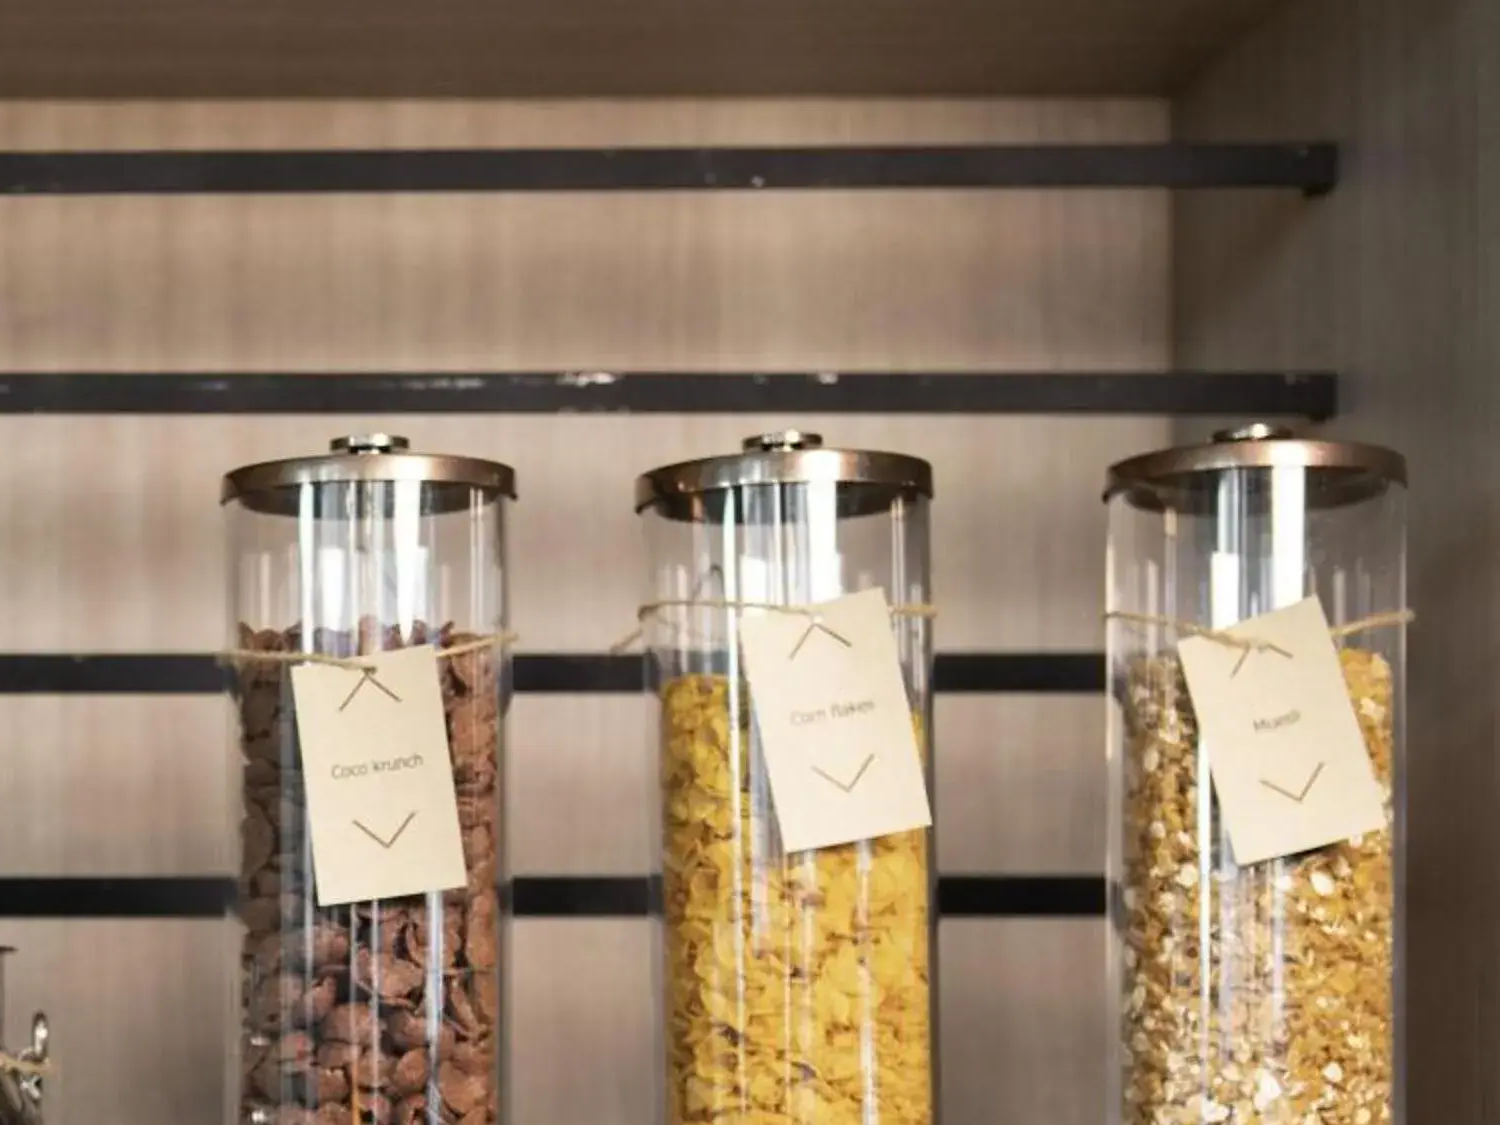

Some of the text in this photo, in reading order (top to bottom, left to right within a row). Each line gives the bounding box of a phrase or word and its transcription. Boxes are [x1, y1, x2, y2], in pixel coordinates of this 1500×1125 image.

[790, 699, 875, 725] Corn flakes
[1253, 709, 1302, 732] Muesli
[331, 752, 424, 780] Coco krunch
